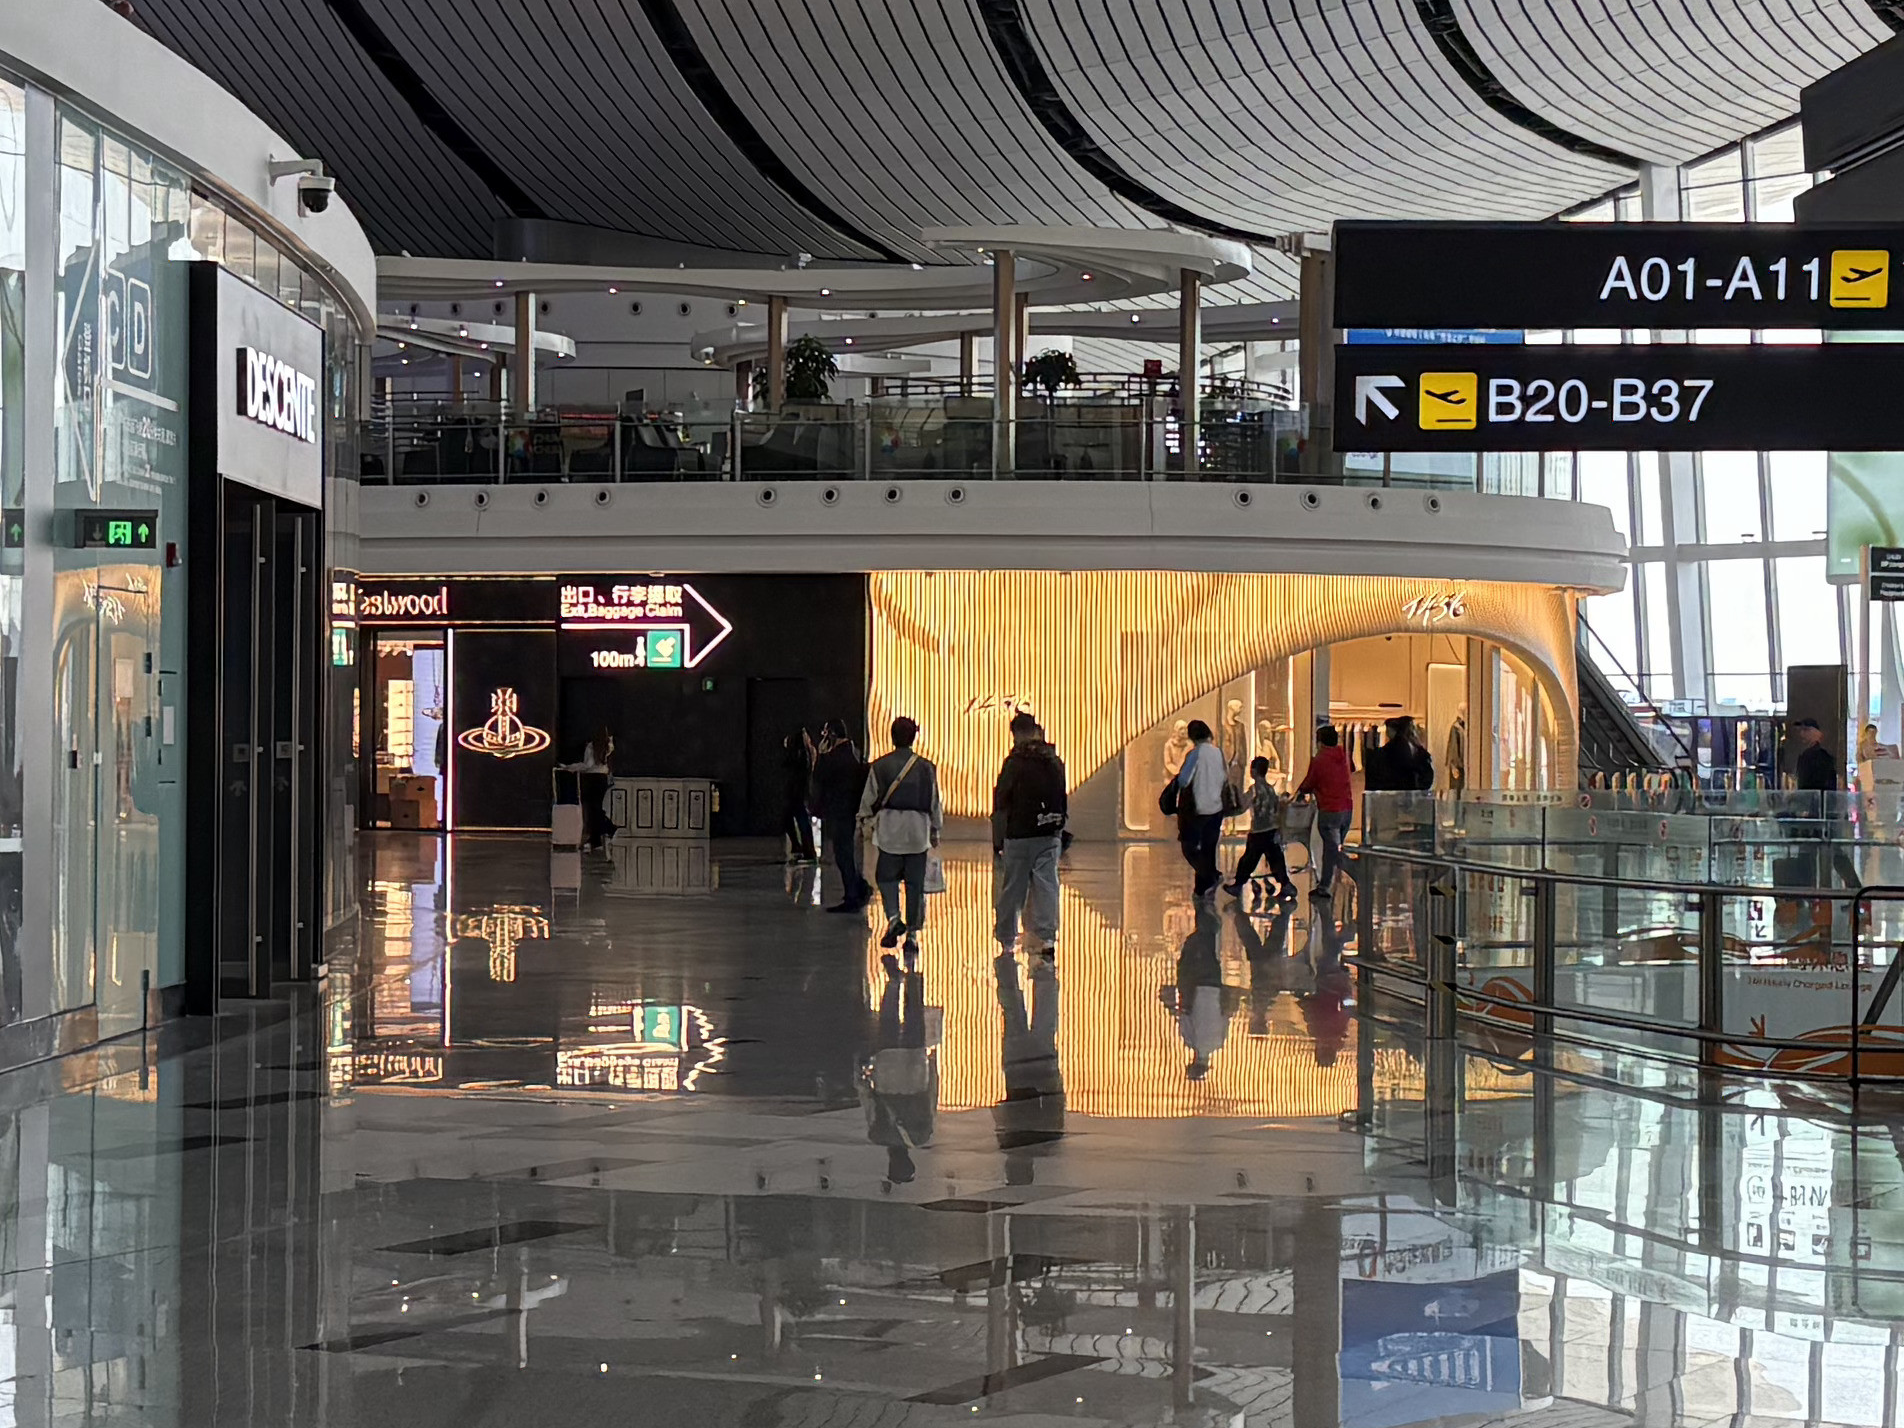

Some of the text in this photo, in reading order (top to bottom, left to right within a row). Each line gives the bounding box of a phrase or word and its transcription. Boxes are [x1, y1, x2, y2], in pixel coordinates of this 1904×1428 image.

[1599, 255, 1821, 303] A01-A11
[246, 346, 316, 444] DESCENTE
[1487, 378, 1714, 423] B20-B37
[645, 603, 683, 618] Claim
